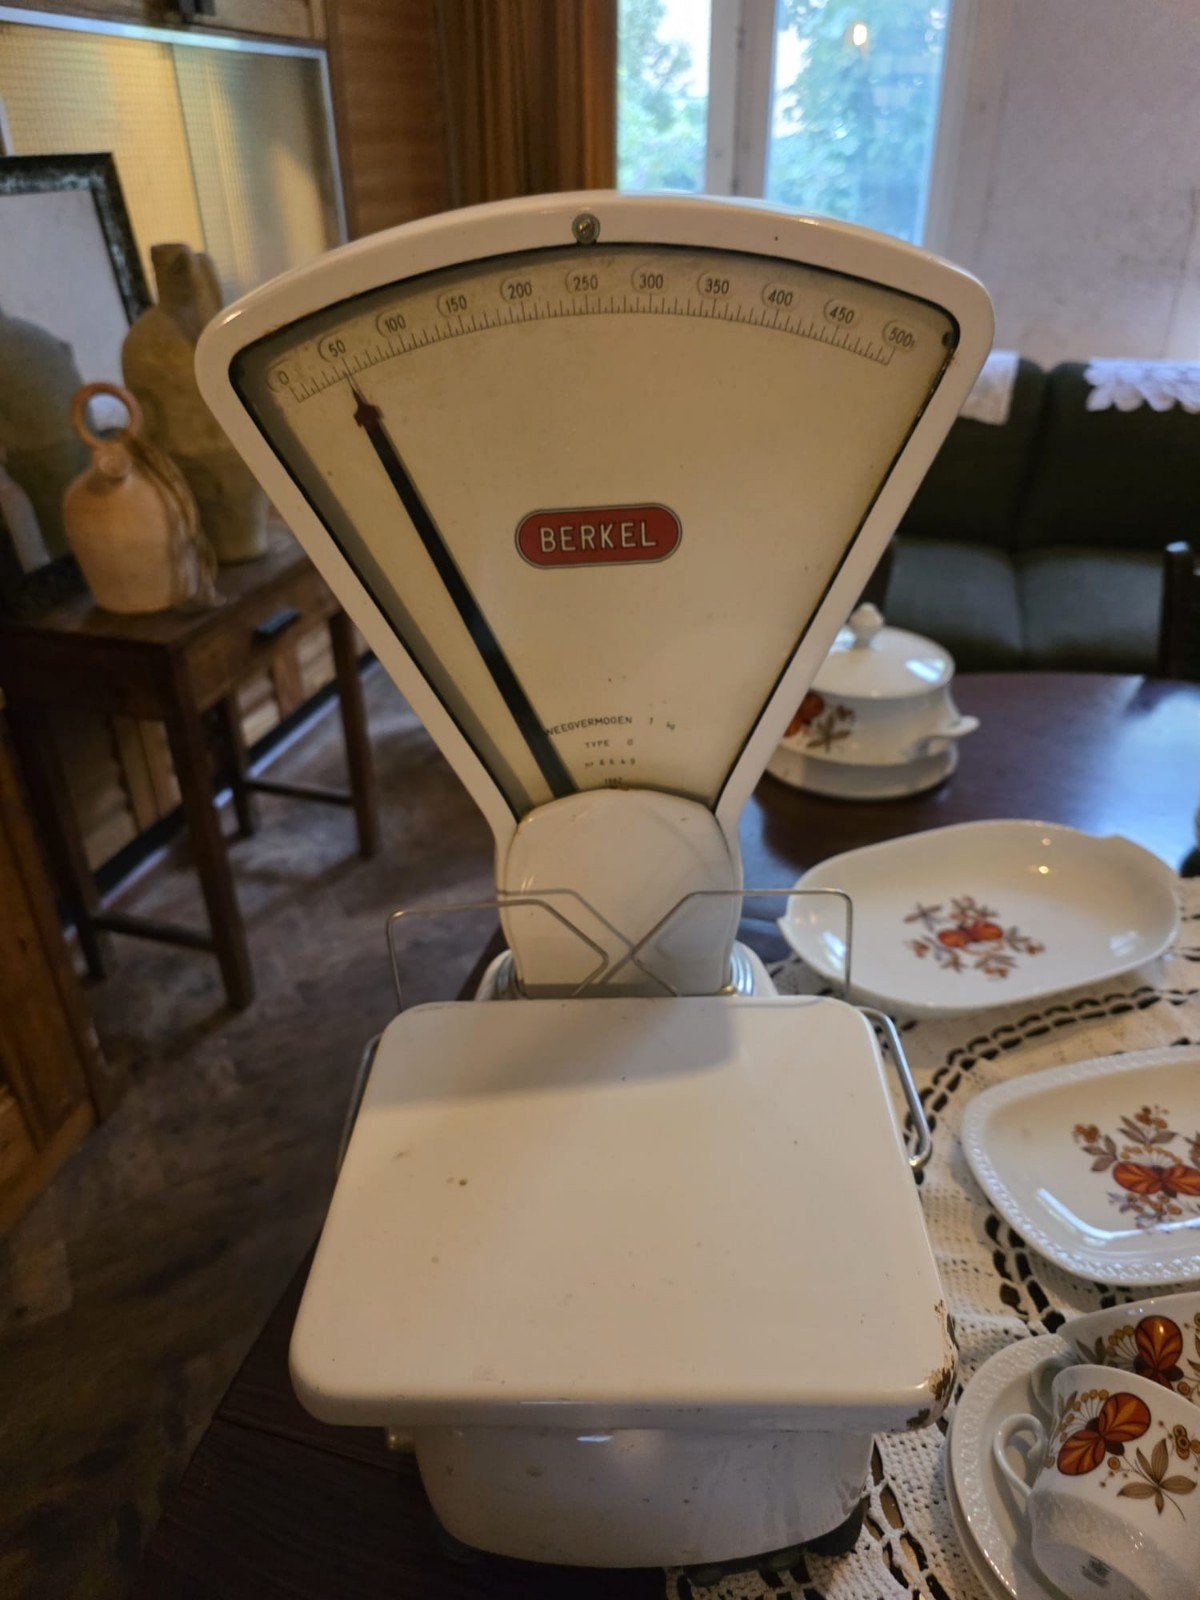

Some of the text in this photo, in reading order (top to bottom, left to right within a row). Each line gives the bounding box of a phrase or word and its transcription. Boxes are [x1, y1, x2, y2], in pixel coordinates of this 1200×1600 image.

[277, 370, 290, 386] 0
[327, 339, 346, 358] 50
[384, 314, 407, 334] 100
[444, 294, 468, 314] 150
[507, 281, 532, 300] 200
[572, 273, 599, 292] 250
[638, 273, 664, 290] 300
[704, 278, 730, 295] 350
[768, 288, 793, 307] 400
[829, 307, 855, 325] 450
[539, 521, 657, 553] BERKEL
[584, 739, 610, 749] TYPE
